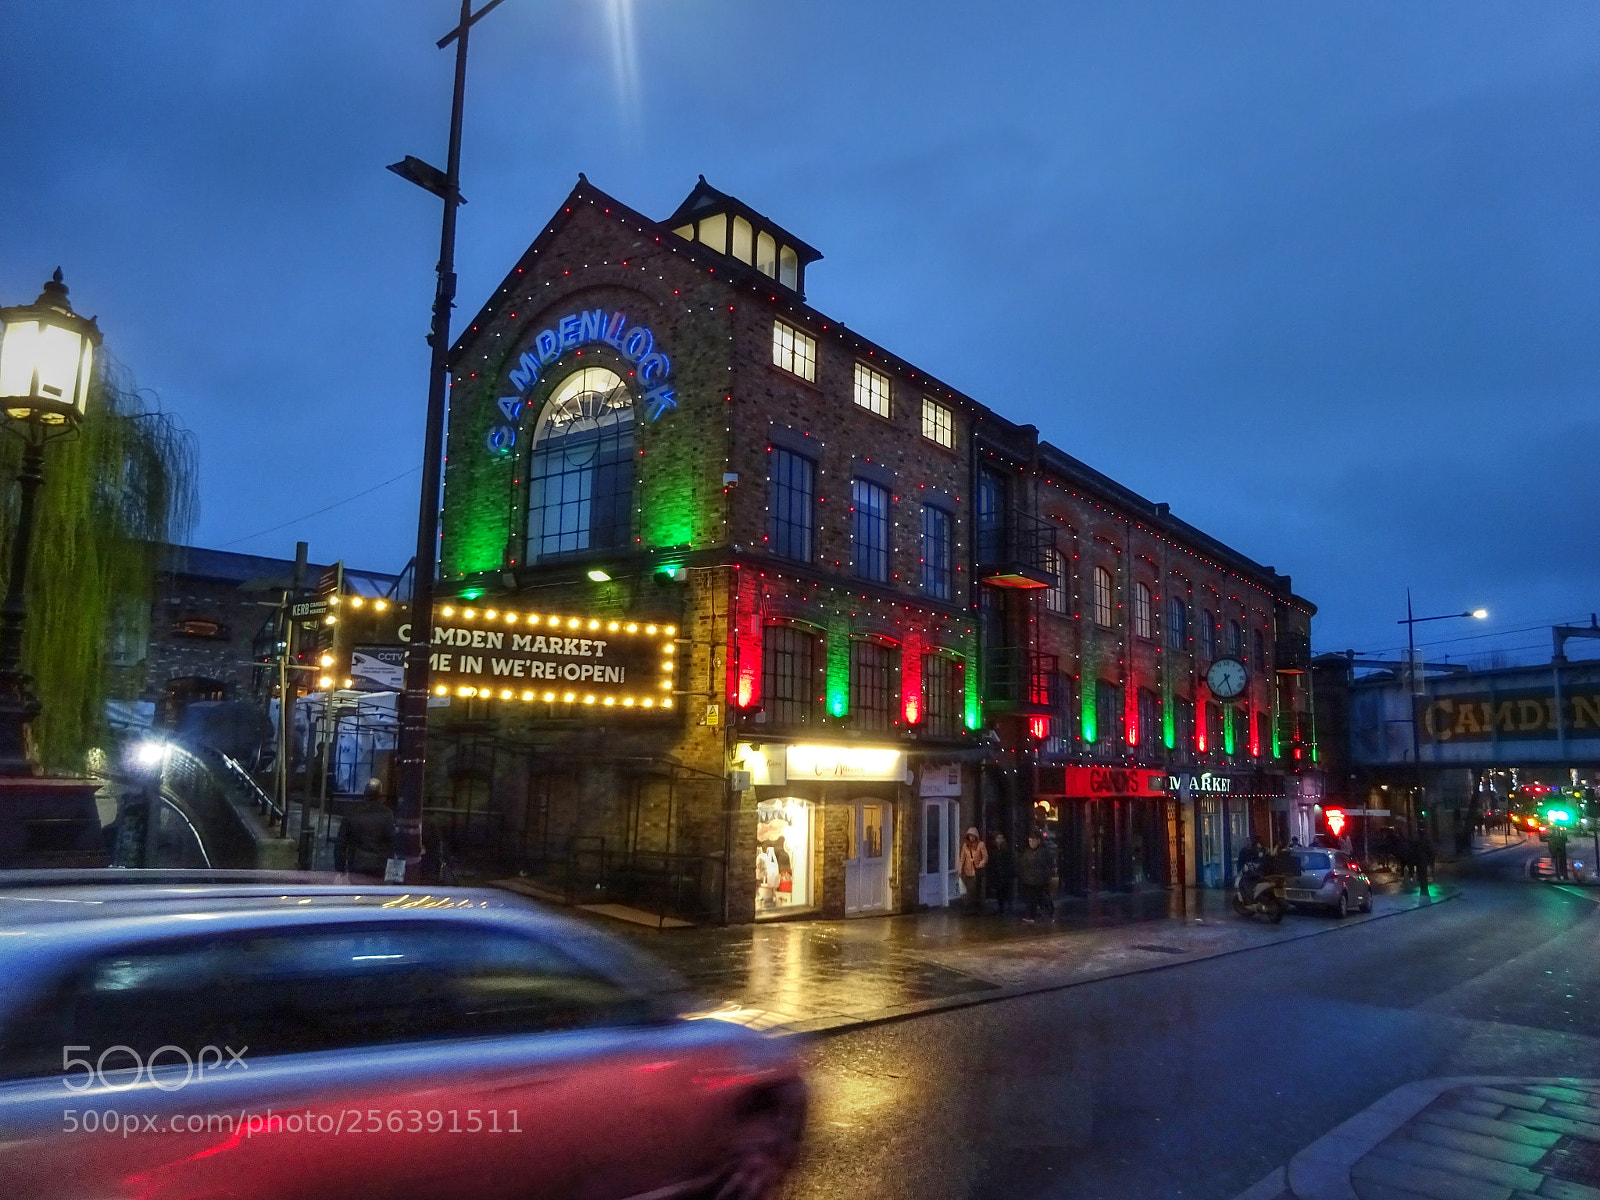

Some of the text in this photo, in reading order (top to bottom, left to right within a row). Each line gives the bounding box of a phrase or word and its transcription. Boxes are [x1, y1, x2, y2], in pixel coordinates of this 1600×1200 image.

[487, 309, 677, 454] CAMDEN LOCK
[292, 603, 310, 616] KERB
[398, 624, 607, 657] CMDEN MARKET
[377, 653, 403, 661] CCTV
[460, 655, 483, 674] IN
[491, 658, 557, 680] WE'RE
